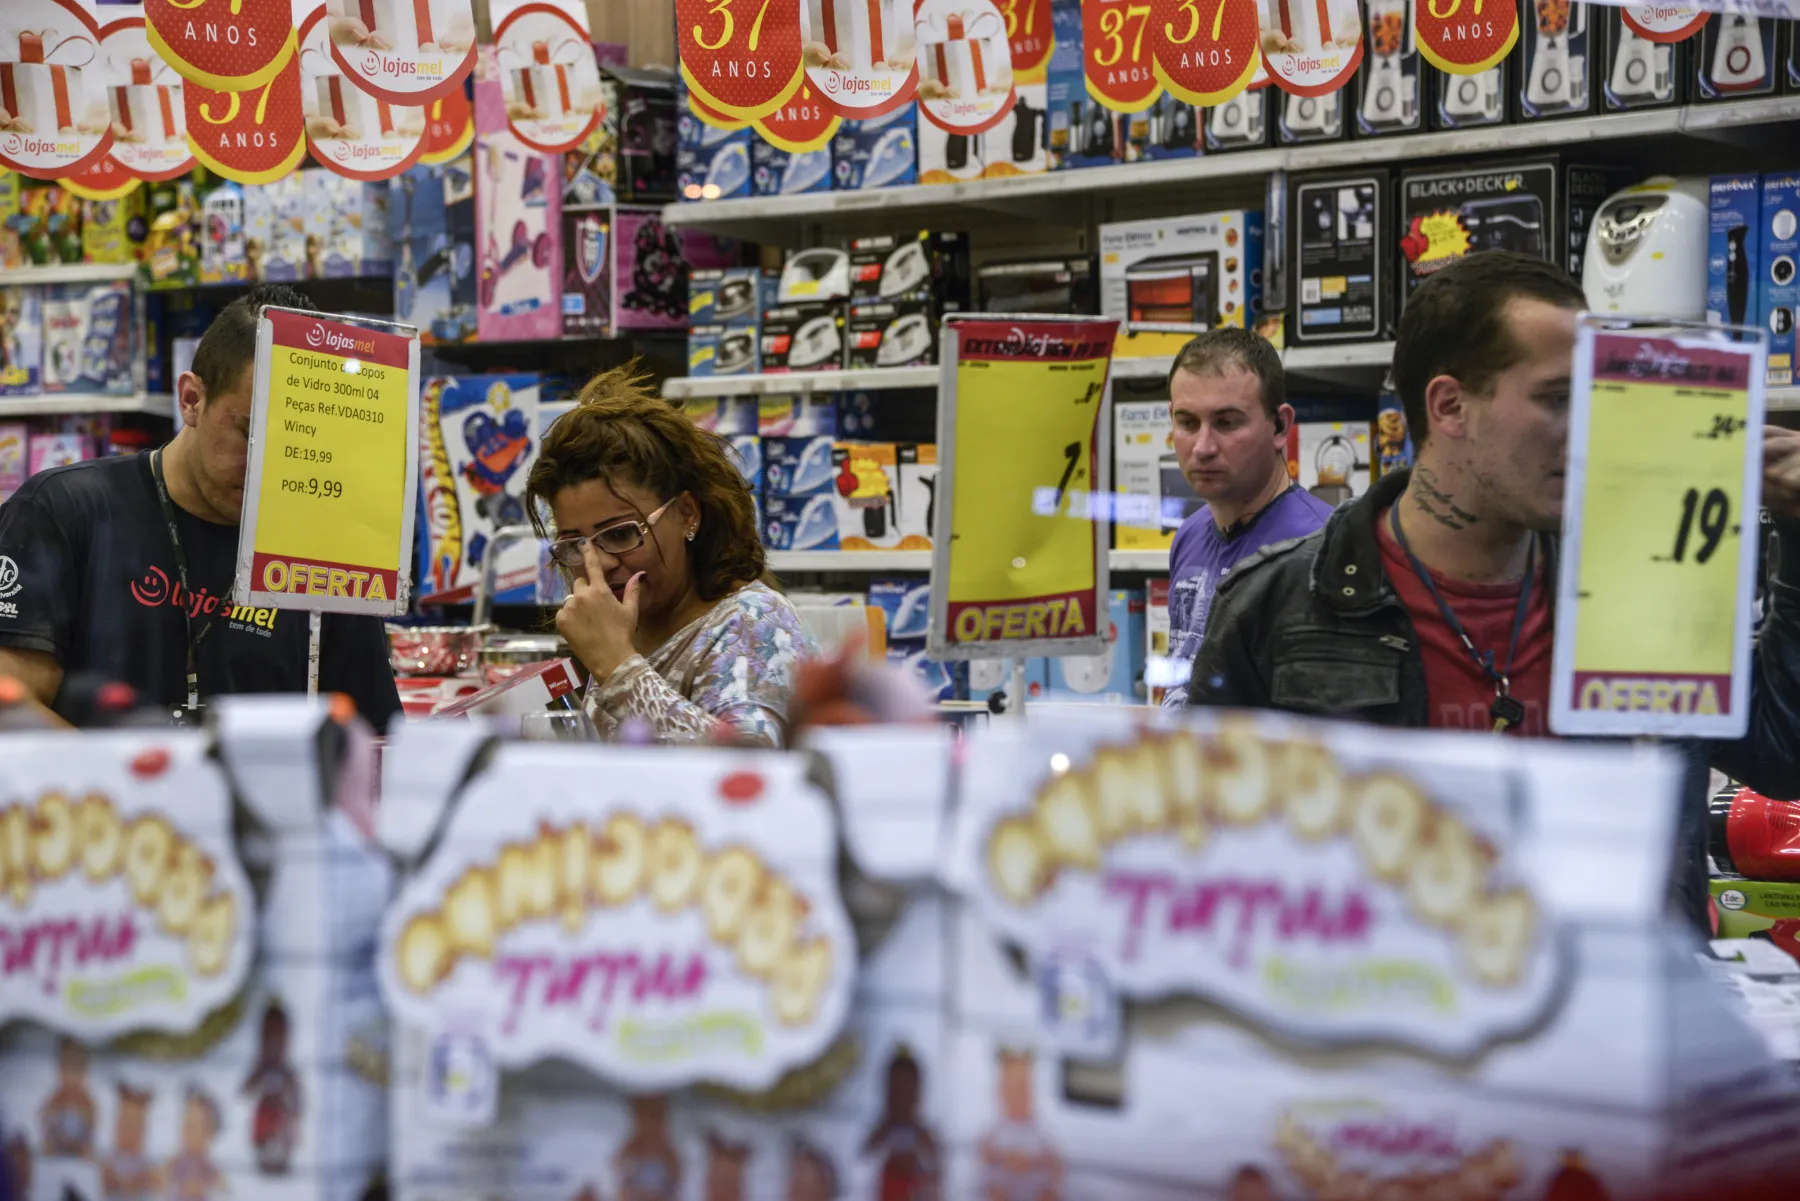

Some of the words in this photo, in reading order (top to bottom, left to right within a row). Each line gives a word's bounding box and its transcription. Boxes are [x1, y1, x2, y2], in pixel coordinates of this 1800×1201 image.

[693, 0, 771, 51] 37
[1165, 0, 1226, 44] 37
[1443, 22, 1493, 42] ANOS
[185, 21, 257, 46] ANOS
[1094, 4, 1151, 66] 37
[382, 57, 443, 77] lojasmel
[1181, 48, 1231, 69] ANOS
[1297, 54, 1340, 74] lojasmel
[712, 60, 771, 78] ANOS
[1108, 67, 1149, 85] ANOS
[842, 75, 892, 95] lojasmel
[775, 106, 820, 122] ANOS
[24, 138, 80, 157] lojasmel
[219, 131, 278, 148] ANOS
[326, 331, 376, 355] lojasmel
[290, 352, 338, 370] Conjunto
[286, 374, 300, 388] de
[303, 377, 331, 393] Vidro
[333, 382, 365, 398] 300ml
[366, 388, 379, 401] 04
[285, 396, 315, 413] Peças
[318, 401, 384, 424] Ref.VDA0310
[284, 419, 317, 438] Wincy
[284, 445, 333, 464] DE:19,99
[281, 478, 343, 499] POR:9,99
[1673, 488, 1730, 564] 19
[263, 560, 388, 601] OFERTA
[229, 621, 244, 631] tem
[245, 624, 256, 634] de
[256, 627, 272, 639] tudo
[957, 598, 1084, 642] OFERTA
[1580, 681, 1719, 715] OFERTA
